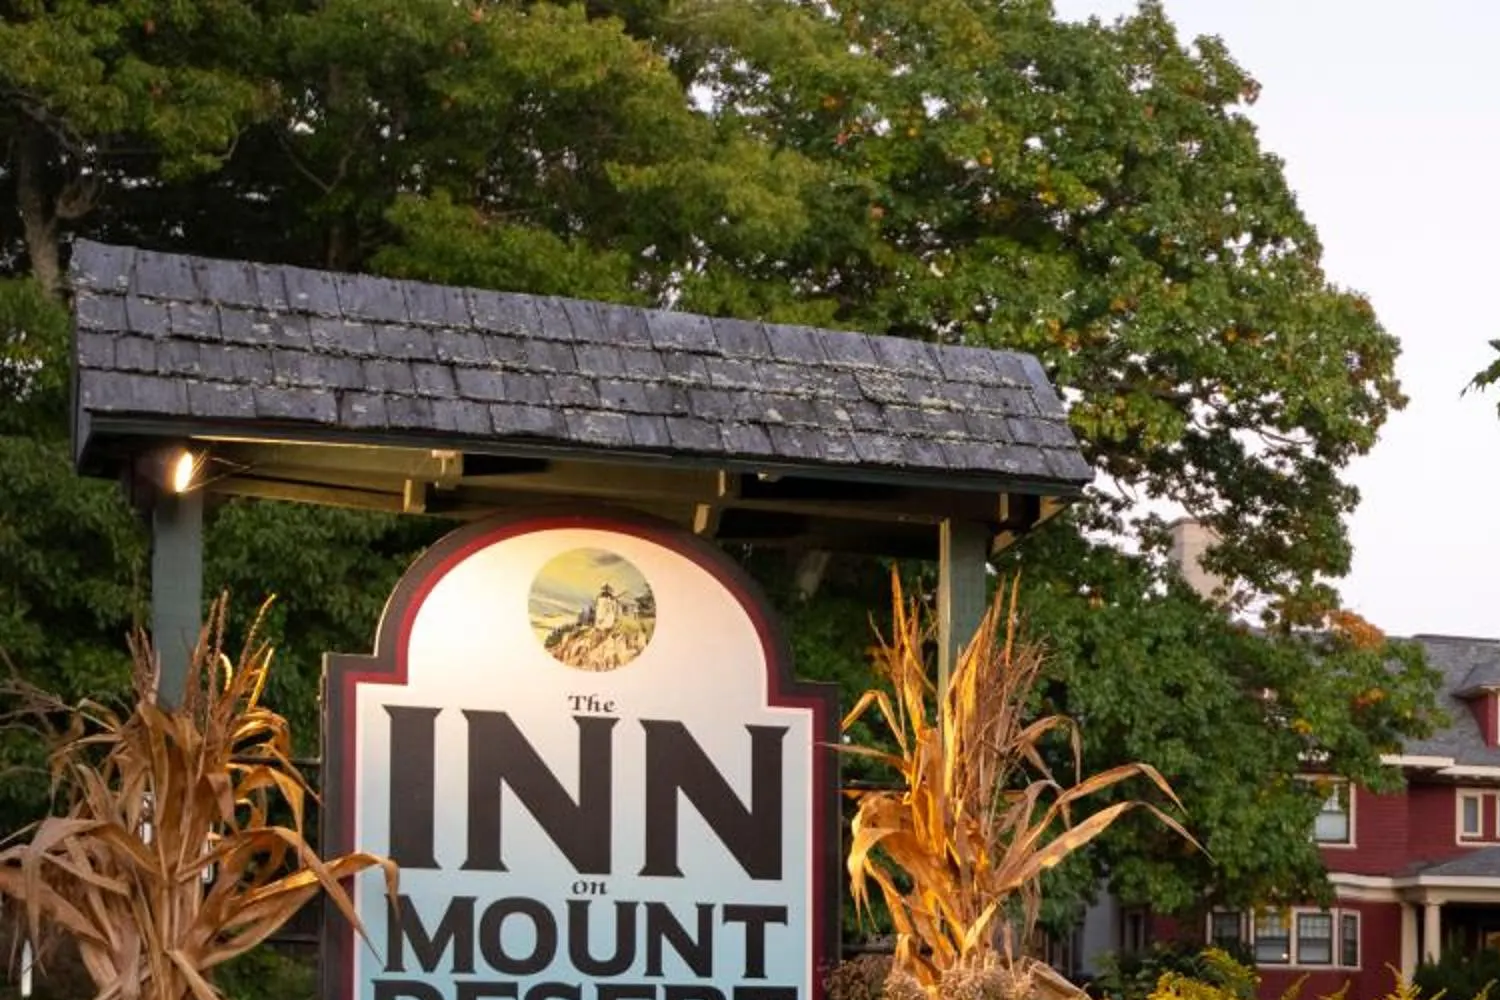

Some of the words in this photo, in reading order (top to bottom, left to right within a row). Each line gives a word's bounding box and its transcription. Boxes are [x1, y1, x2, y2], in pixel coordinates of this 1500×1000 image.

[568, 694, 616, 713] The
[382, 704, 791, 881] INN
[572, 879, 608, 897] on
[382, 893, 789, 979] MOUNT
